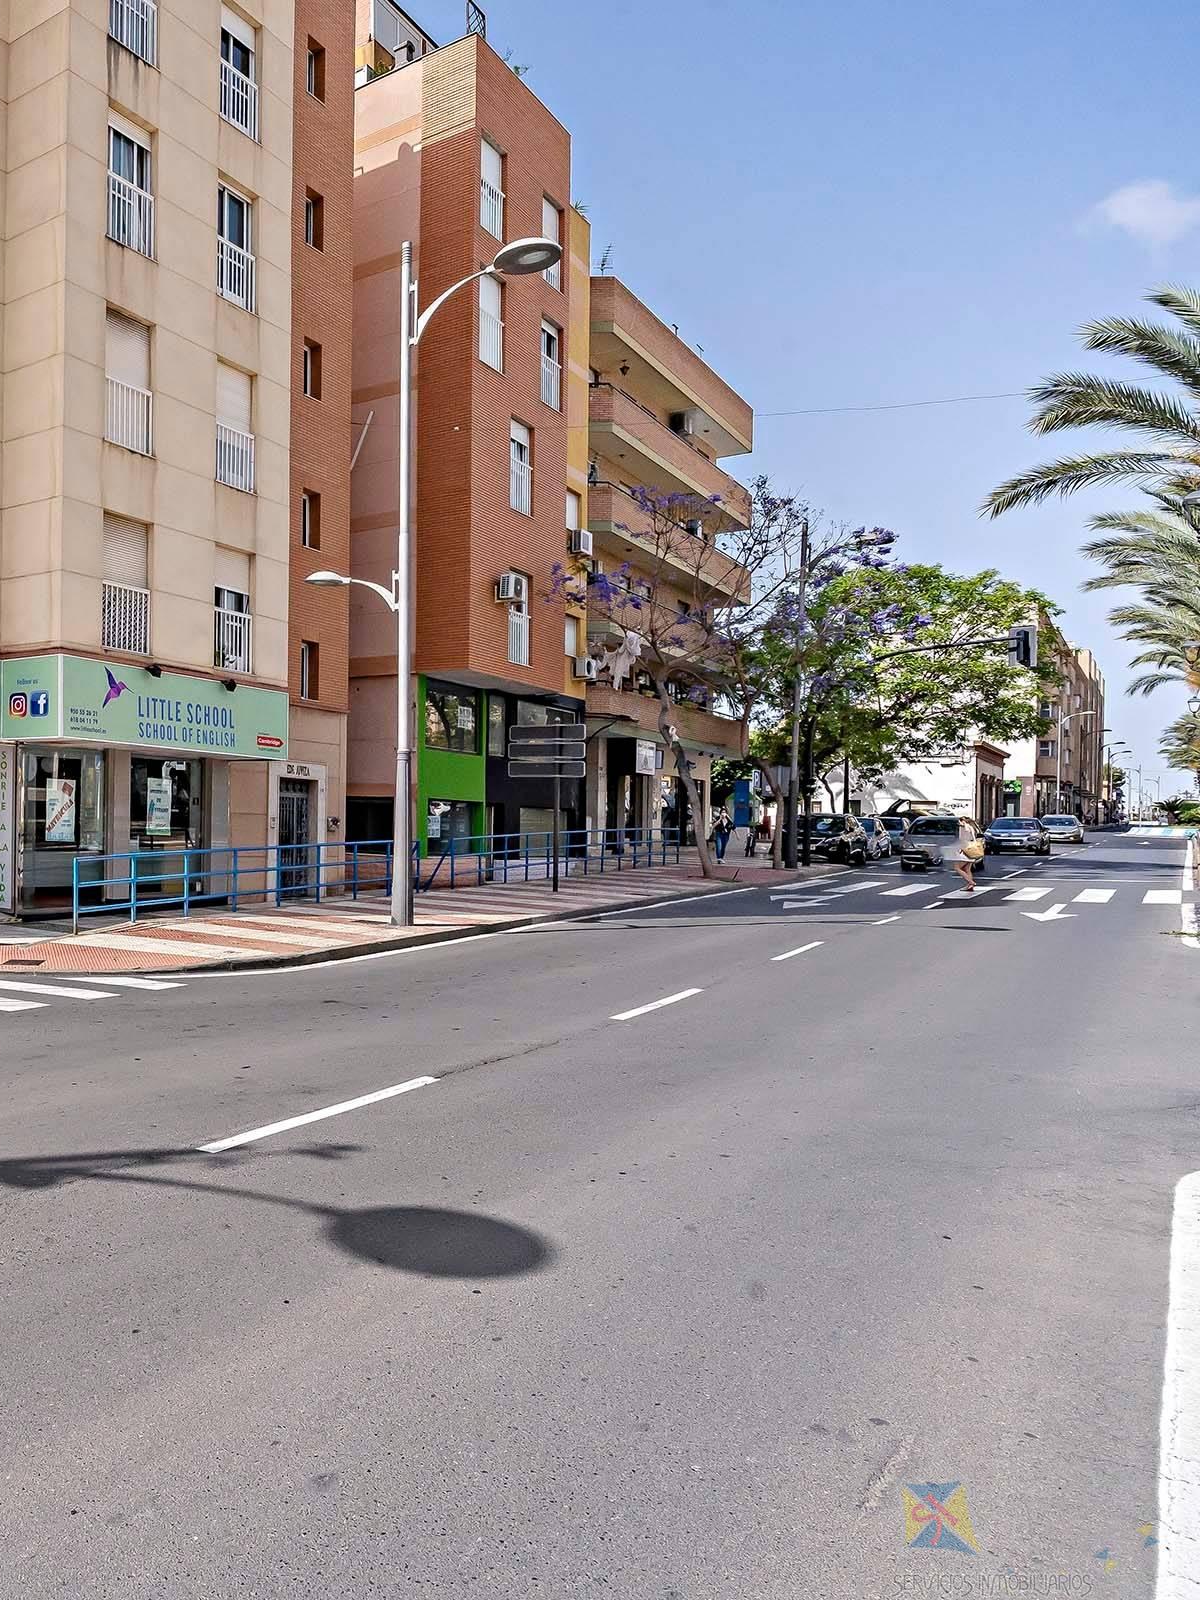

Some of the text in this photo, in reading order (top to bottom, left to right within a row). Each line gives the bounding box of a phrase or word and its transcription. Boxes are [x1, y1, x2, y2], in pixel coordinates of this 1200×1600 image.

[138, 695, 235, 729] LITTLE SCHOOL
[138, 722, 236, 748] SCHOOL OF ENGLISH
[0, 751, 8, 811] SONRIE
